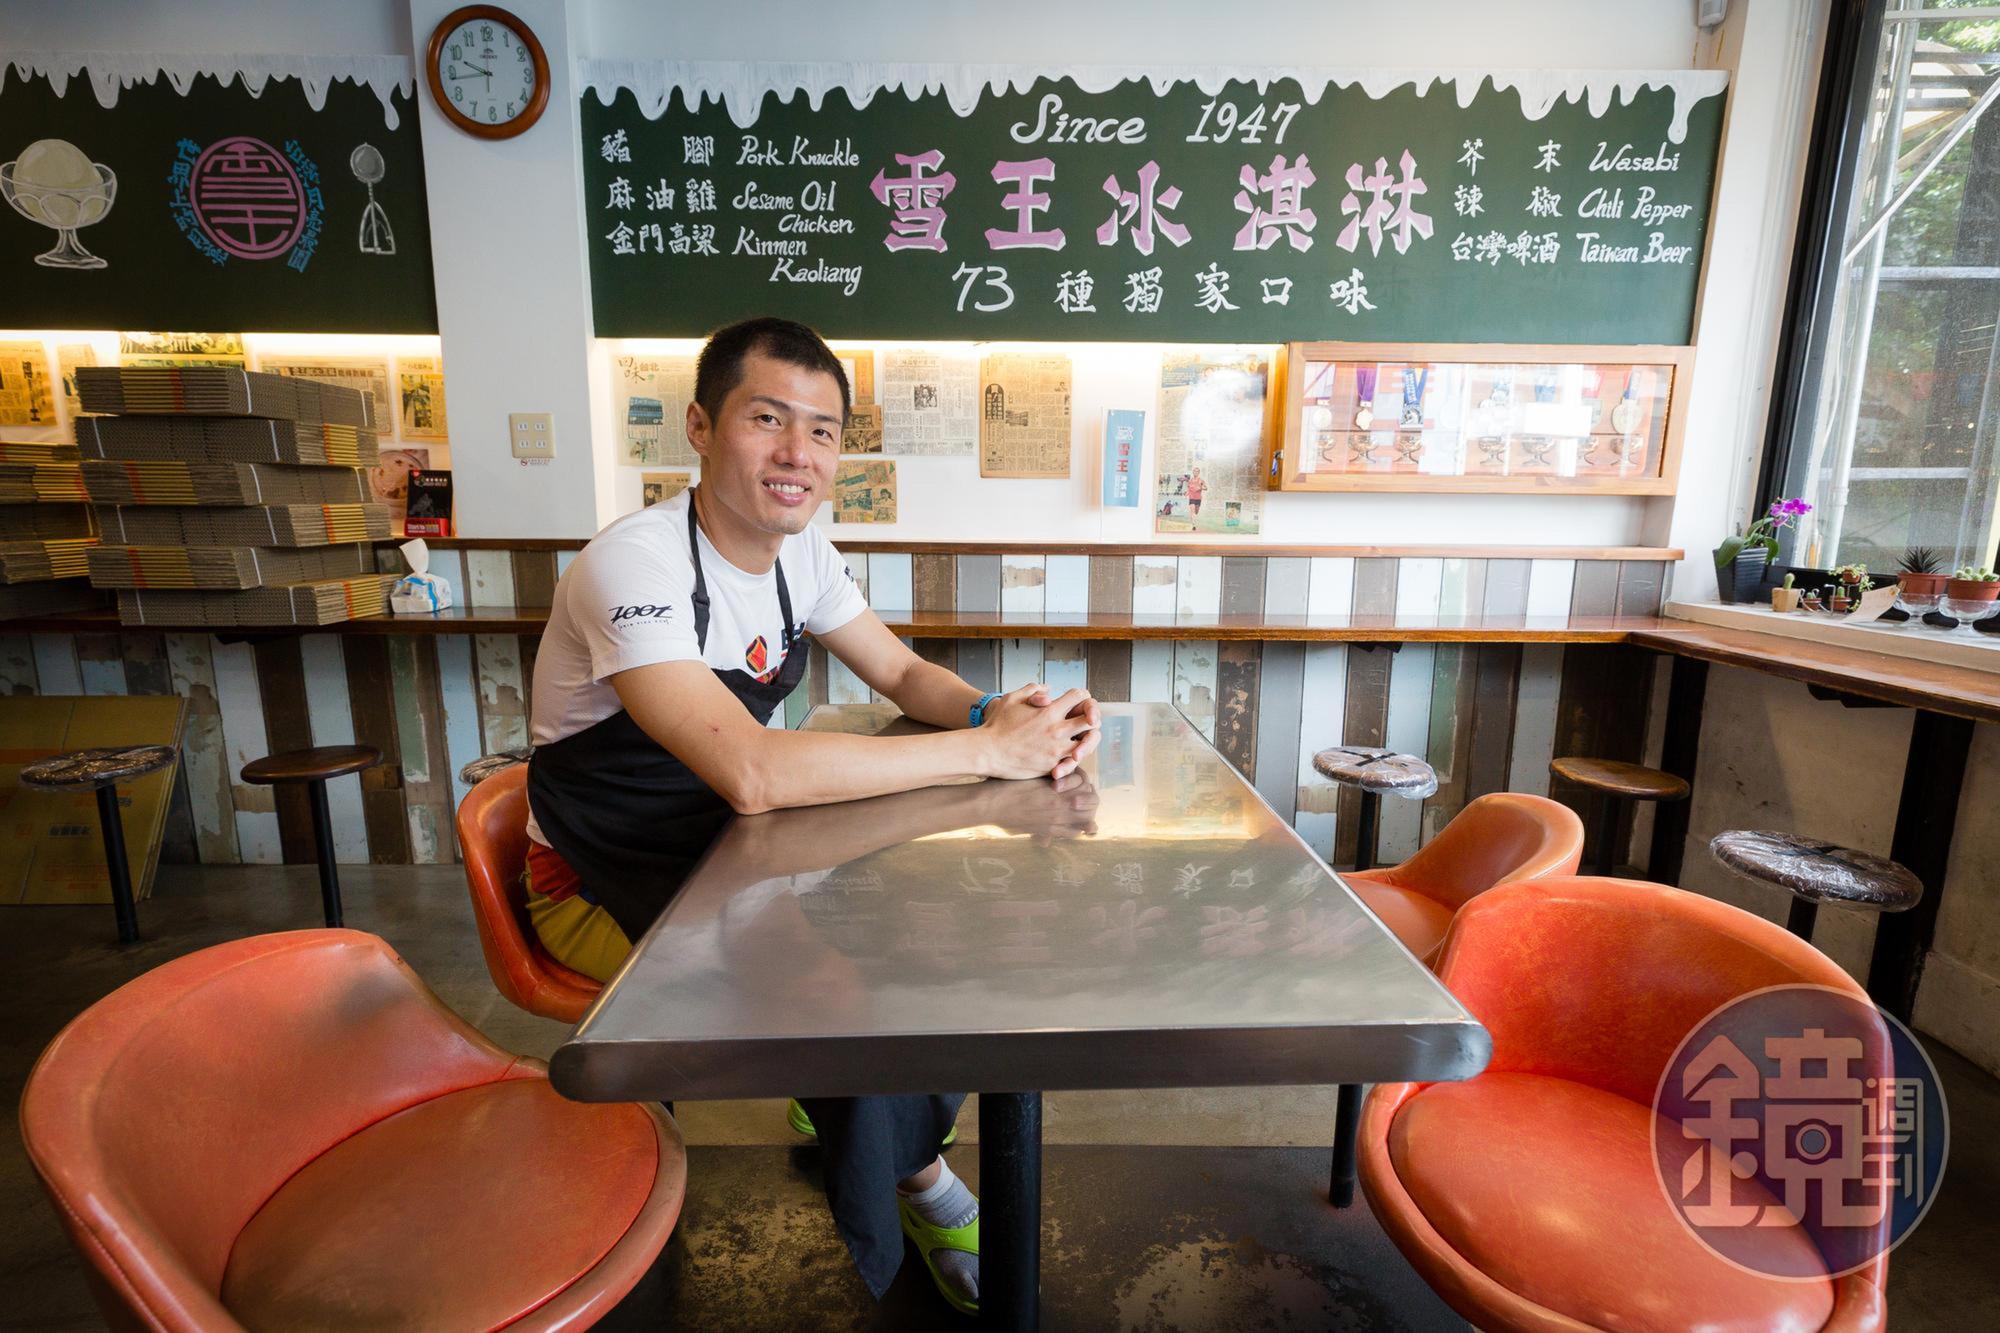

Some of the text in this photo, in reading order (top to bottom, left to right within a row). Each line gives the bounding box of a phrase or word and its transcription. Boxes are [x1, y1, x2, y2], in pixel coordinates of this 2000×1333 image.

[462, 30, 475, 47] 11
[480, 25, 493, 42] 12
[502, 31, 510, 48] 1
[450, 44, 463, 61] 10
[516, 46, 526, 62] 2
[523, 68, 533, 84] 3
[454, 86, 463, 101] 8
[519, 88, 528, 103] 4
[469, 101, 478, 117] 7
[488, 106, 498, 122] 6
[506, 102, 516, 118] 5
[1010, 93, 1302, 145] Since 1947
[736, 134, 860, 167] Pork Knuckle
[1588, 141, 1680, 172] Wasabi
[605, 176, 717, 213] 麻油雞
[732, 180, 837, 212] Sesame Oil
[869, 148, 1434, 258] 雪王冰淇淋
[1577, 185, 1692, 226] Chili Pepper
[778, 213, 856, 234] Chicken
[731, 225, 808, 256] Kinmen
[1451, 230, 1561, 266] 台灣啤酒
[1576, 231, 1692, 264] Taiwan Beer
[769, 257, 863, 296] Kaoliang
